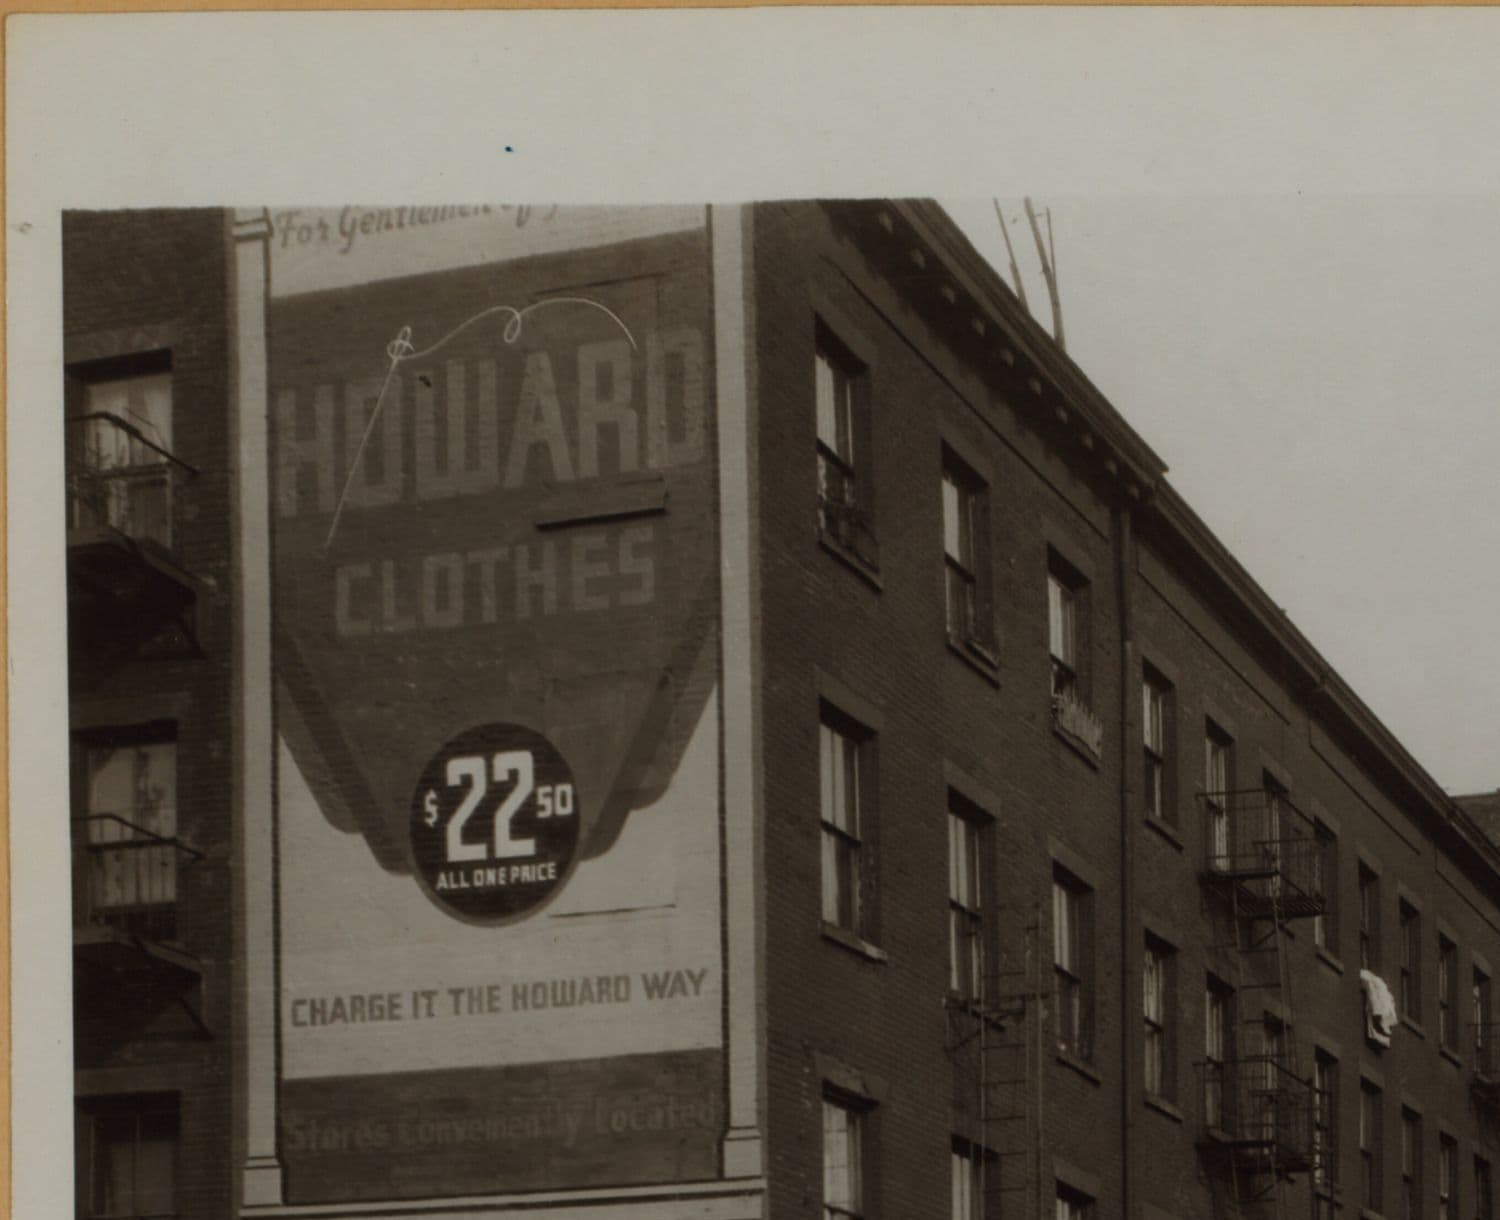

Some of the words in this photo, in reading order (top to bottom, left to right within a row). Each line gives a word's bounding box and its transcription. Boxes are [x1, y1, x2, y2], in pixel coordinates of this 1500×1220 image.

[275, 210, 331, 249] For
[276, 327, 703, 518] HOWARD
[335, 525, 656, 638] CLOTHES
[436, 870, 469, 890] ALL
[473, 867, 505, 887] ONE
[510, 861, 557, 884] PRICE
[290, 991, 402, 1028] CHARGE
[411, 988, 440, 1020] IT
[447, 984, 501, 1016] THE
[511, 972, 632, 1012] HOWARD
[640, 966, 710, 1001] WAY
[286, 1116, 390, 1152] Stores
[595, 1092, 717, 1134] Located
